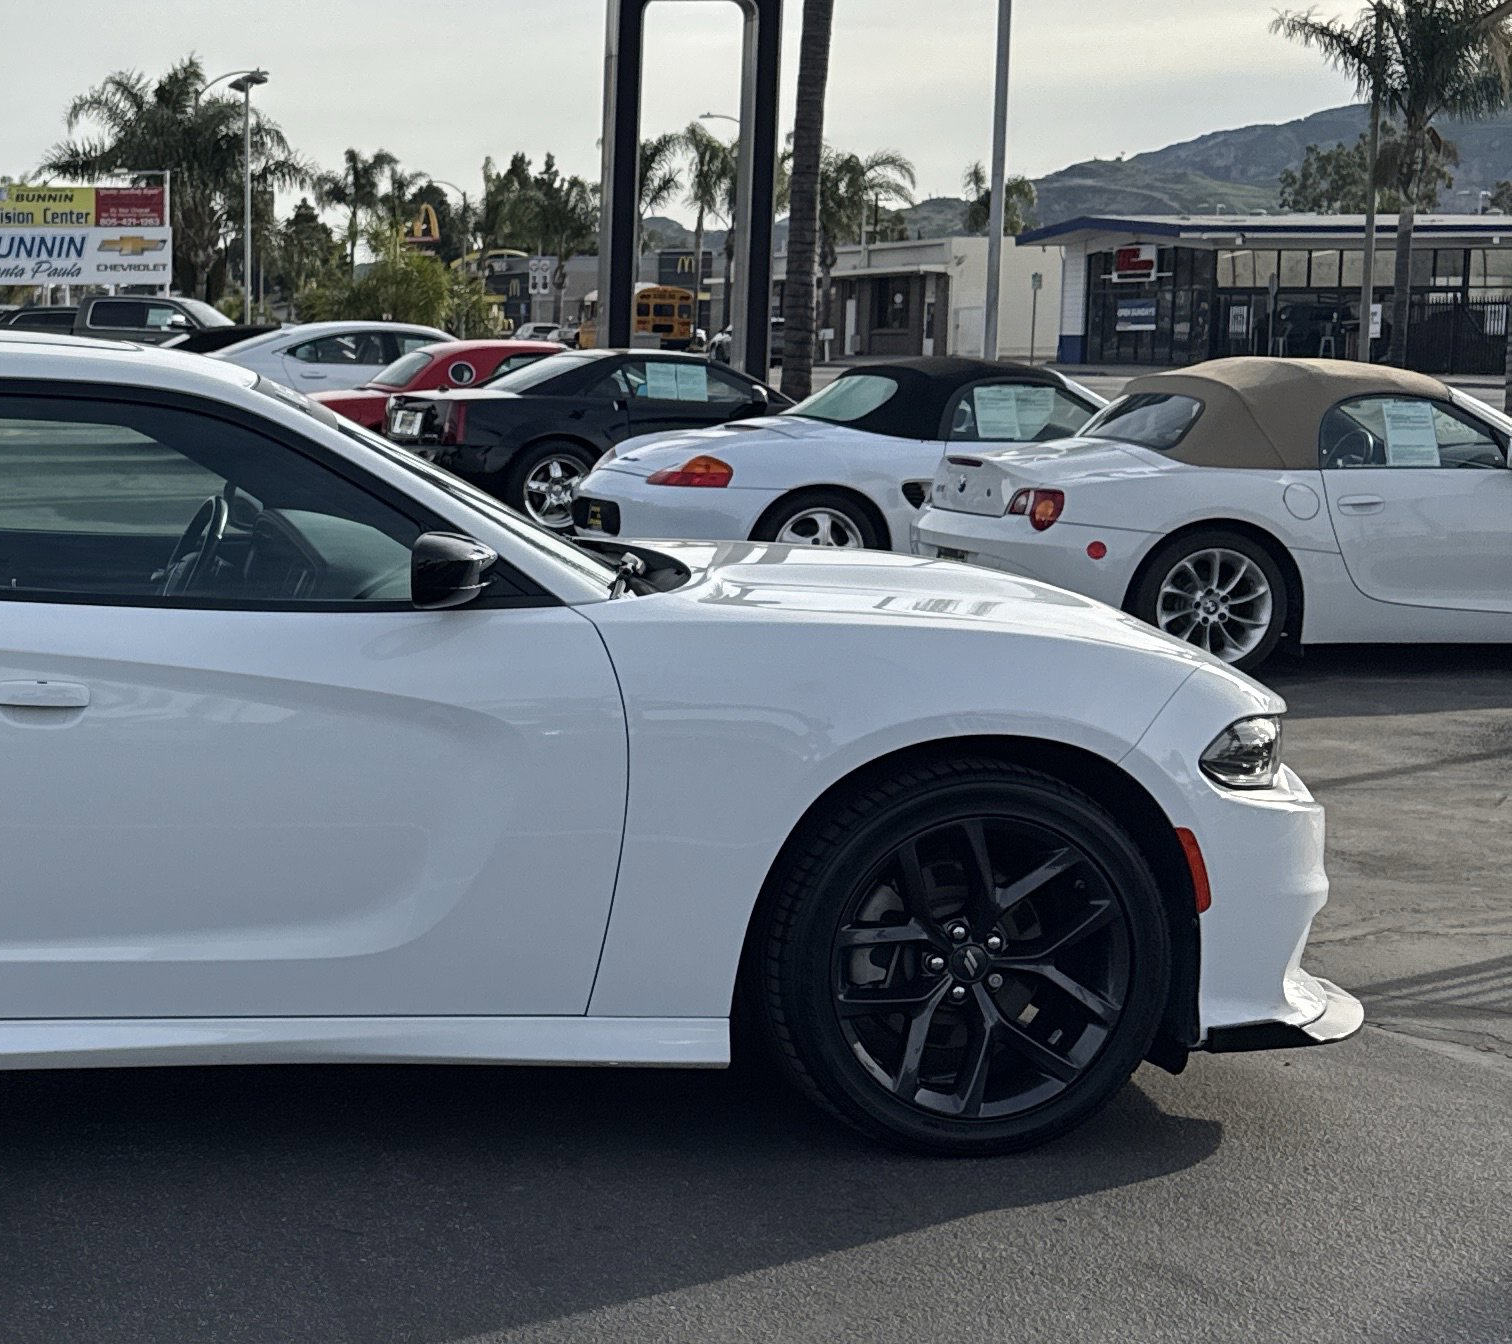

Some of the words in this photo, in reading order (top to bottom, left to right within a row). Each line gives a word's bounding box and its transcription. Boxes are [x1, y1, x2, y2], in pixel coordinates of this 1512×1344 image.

[15, 193, 74, 203] BUNNIN
[43, 207, 90, 224] Center
[31, 260, 82, 279] Paula
[96, 263, 168, 272] CHEVROLET
